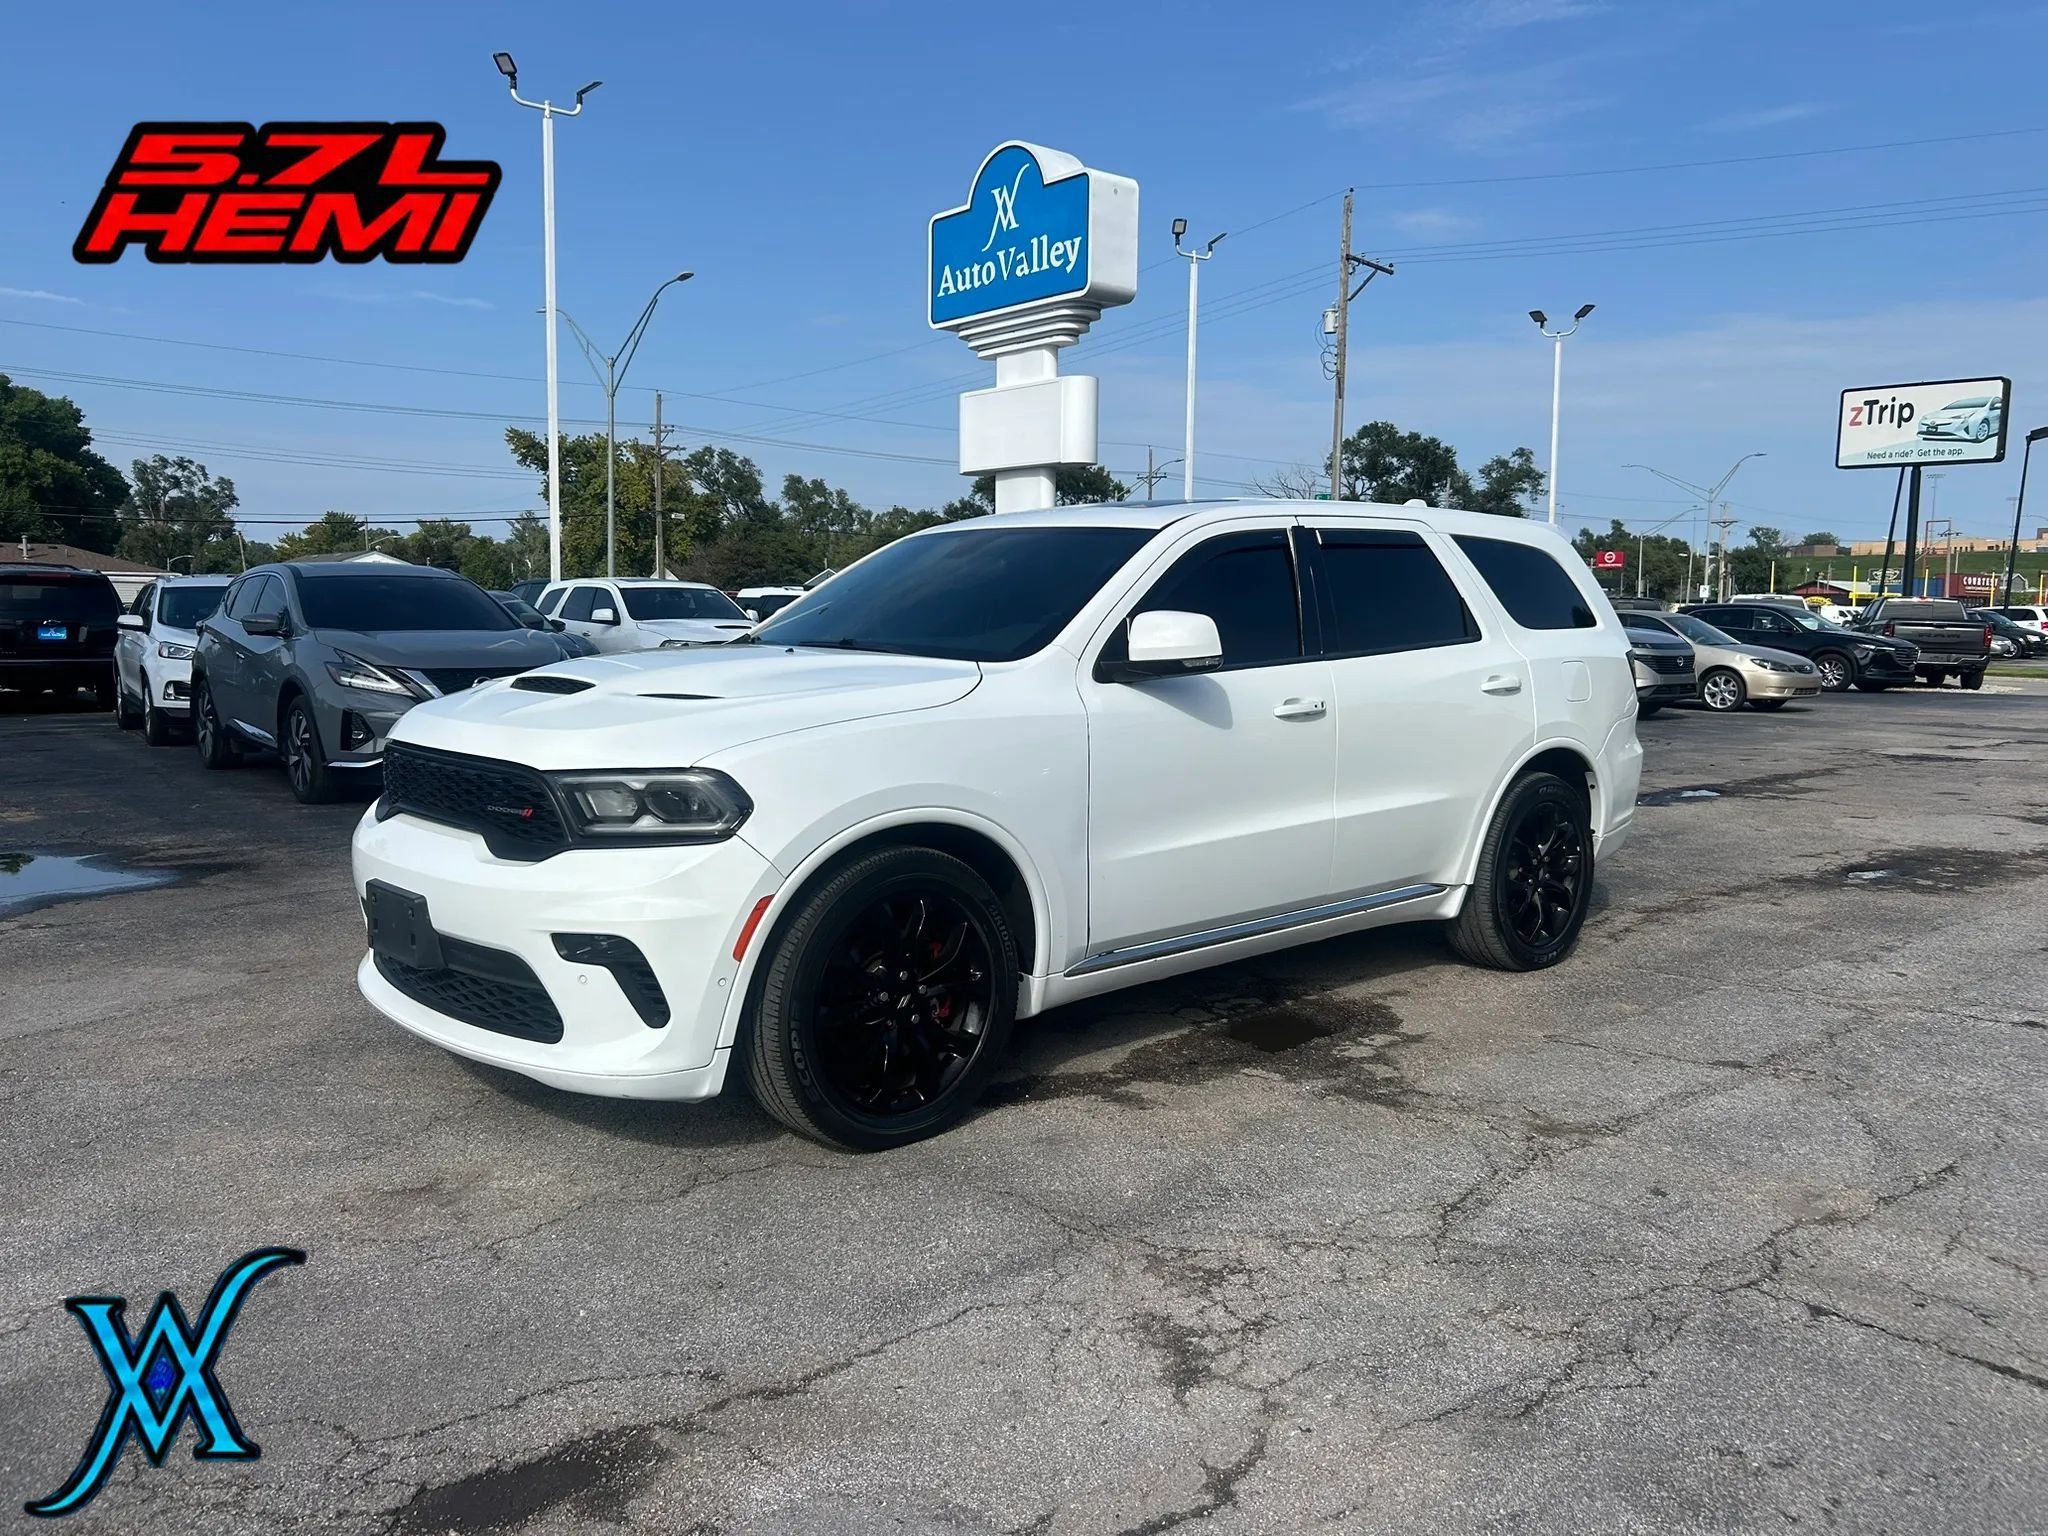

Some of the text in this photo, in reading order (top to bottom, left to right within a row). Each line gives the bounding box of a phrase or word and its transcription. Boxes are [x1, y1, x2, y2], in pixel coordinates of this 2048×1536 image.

[1849, 396, 1915, 429] zTrip
[1866, 451, 1887, 460] Need
[1894, 449, 1914, 459] ride?
[1917, 448, 1931, 457] Get
[1933, 448, 1946, 456] the
[1947, 448, 1965, 457] app.
